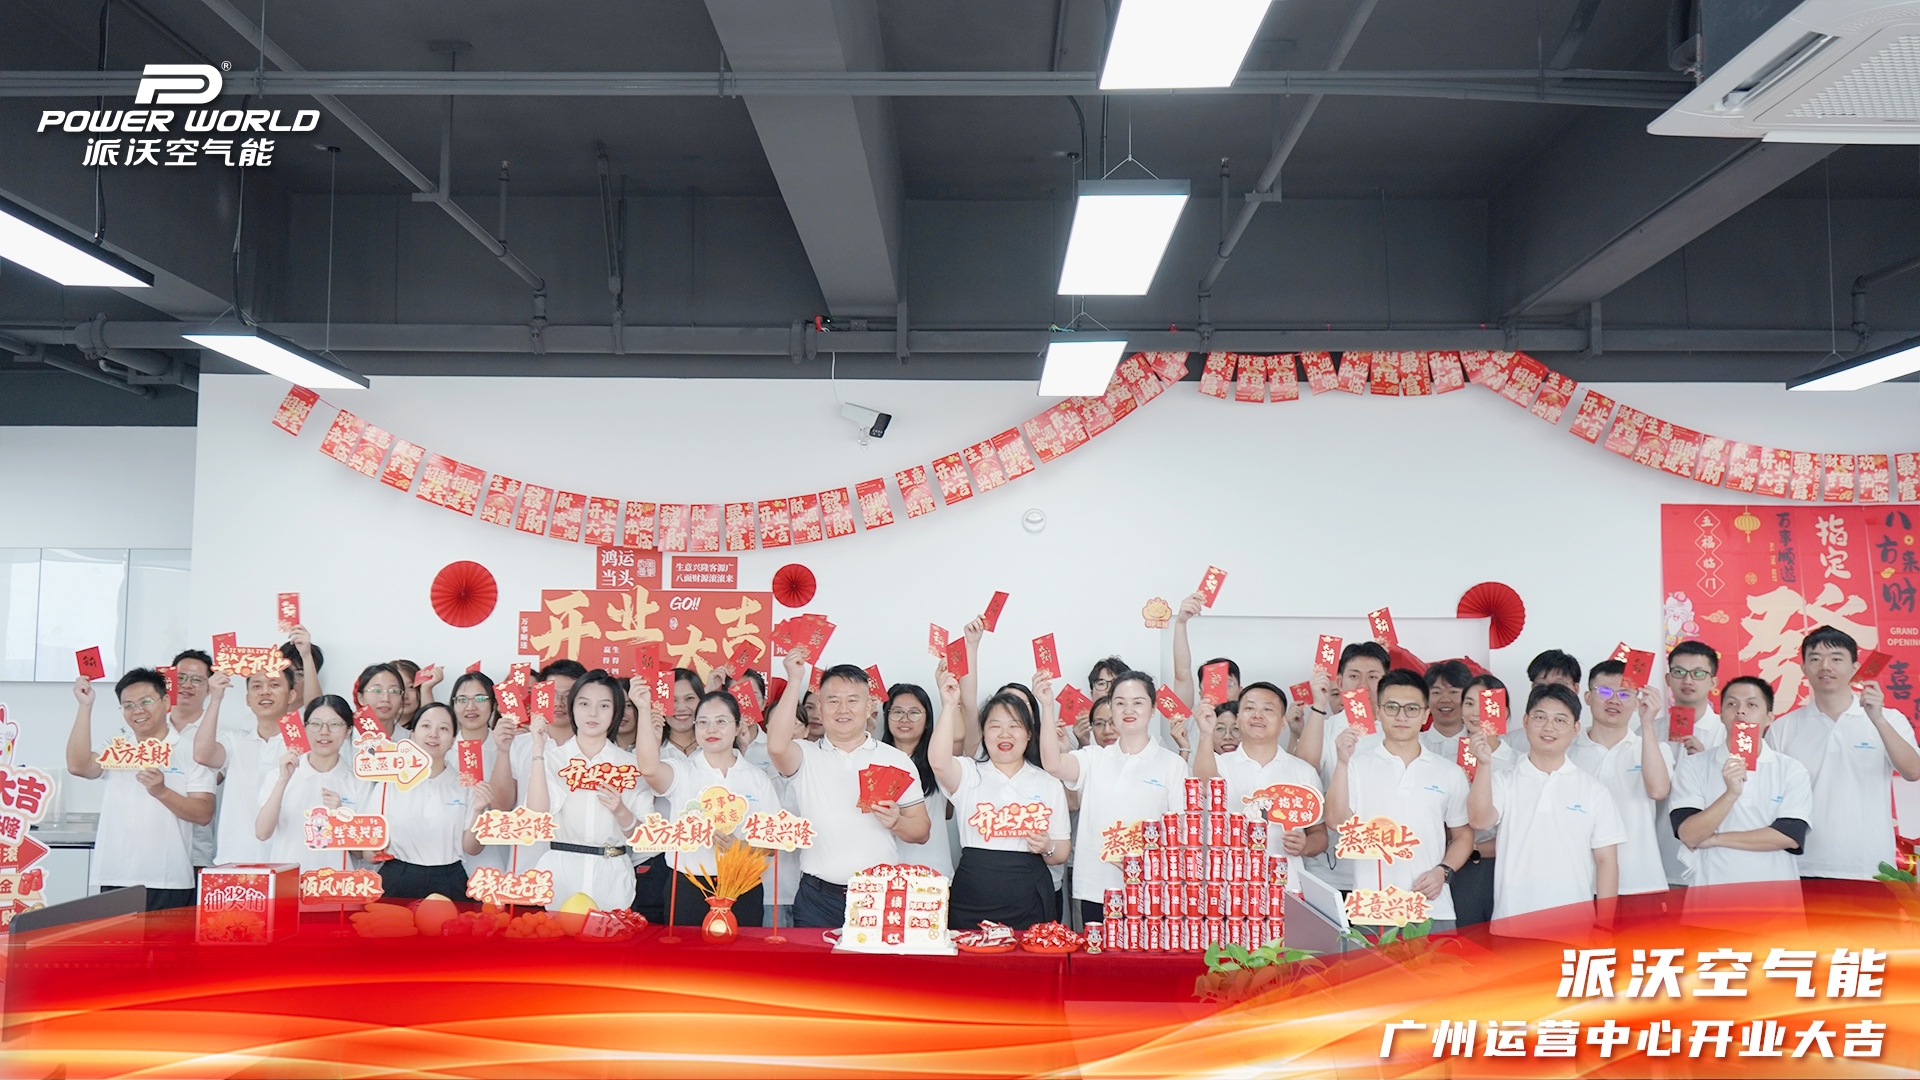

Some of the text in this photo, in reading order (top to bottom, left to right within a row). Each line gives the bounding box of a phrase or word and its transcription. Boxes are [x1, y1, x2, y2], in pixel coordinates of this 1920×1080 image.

[601, 550, 635, 567] 鸿运
[1701, 515, 1718, 590] 五福临门
[1777, 512, 1796, 583] 万事顺遂
[1815, 514, 1851, 579] 指定
[675, 563, 734, 572] 生意兴隆客源广
[1876, 511, 1920, 612] 八方来财
[601, 569, 635, 588] 当头
[675, 574, 734, 583] 八面财源滚滚来
[670, 596, 701, 611] GO!!
[520, 617, 529, 650] 万事顺遂
[1145, 620, 1168, 628] OPEN
[1890, 627, 1918, 636] GRAND
[212, 645, 290, 678] 开业大吉
[1886, 661, 1914, 700] 喜
[359, 755, 422, 771] 蒸蒸日上
[558, 759, 642, 791] 开业大吉
[703, 796, 726, 810] 万事
[714, 809, 740, 824] 顺意
[1278, 796, 1303, 809] 指定
[1288, 809, 1314, 822] 发财
[333, 825, 384, 839] 生意兴隆
[474, 812, 557, 841] 生意兴隆
[745, 814, 815, 845] 生意兴隆
[969, 803, 1052, 841] 开业大吉
[1338, 816, 1420, 864] 蒸蒸日上
[203, 884, 267, 912] 抽奖箱
[301, 876, 382, 899] 顺风顺水
[468, 867, 552, 905] 钱途无量
[887, 879, 907, 943] 业绩长红
[1345, 891, 1430, 920] 生意兴隆
